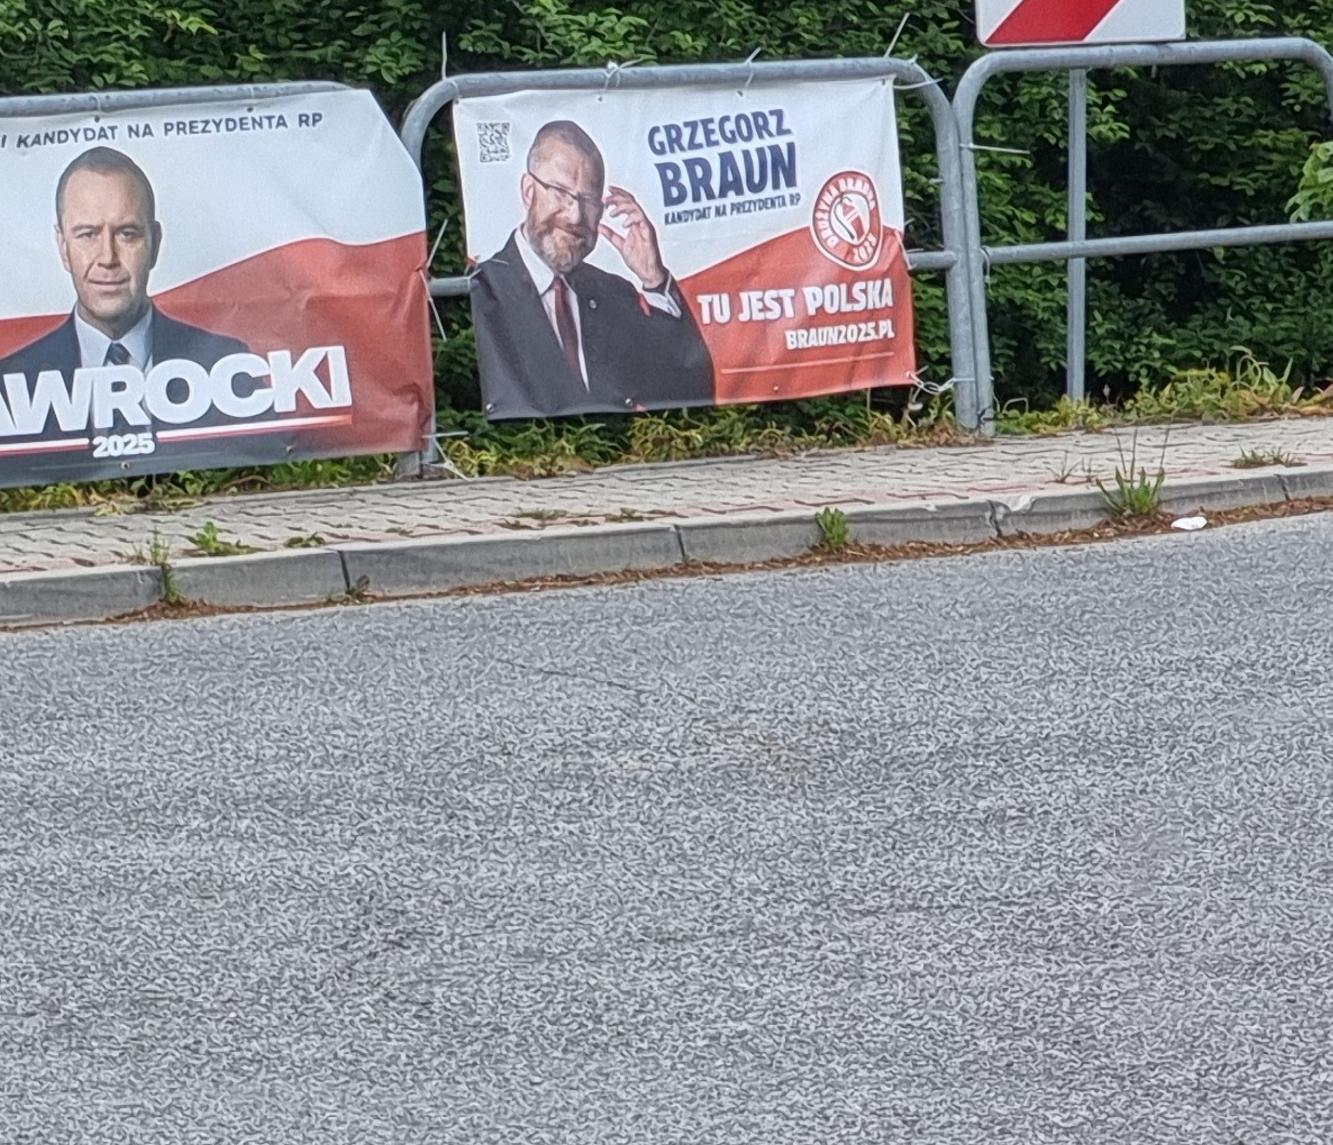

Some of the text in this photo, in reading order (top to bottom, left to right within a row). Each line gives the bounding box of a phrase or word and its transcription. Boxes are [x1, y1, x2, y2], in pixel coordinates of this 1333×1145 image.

[16, 125, 118, 149] KANDYDAT
[127, 123, 154, 139] NA
[164, 114, 288, 136] PREZYDENTA
[298, 112, 323, 127] RP
[647, 108, 792, 156] GRZEGORZ
[653, 142, 797, 207] BRAUN
[664, 192, 801, 226] KANDYDAT NA PREZYDENTA RP
[697, 278, 894, 325] TU JEST POLSKA
[784, 319, 895, 350] BRAUN2025.PL
[92, 432, 156, 458] 2025
